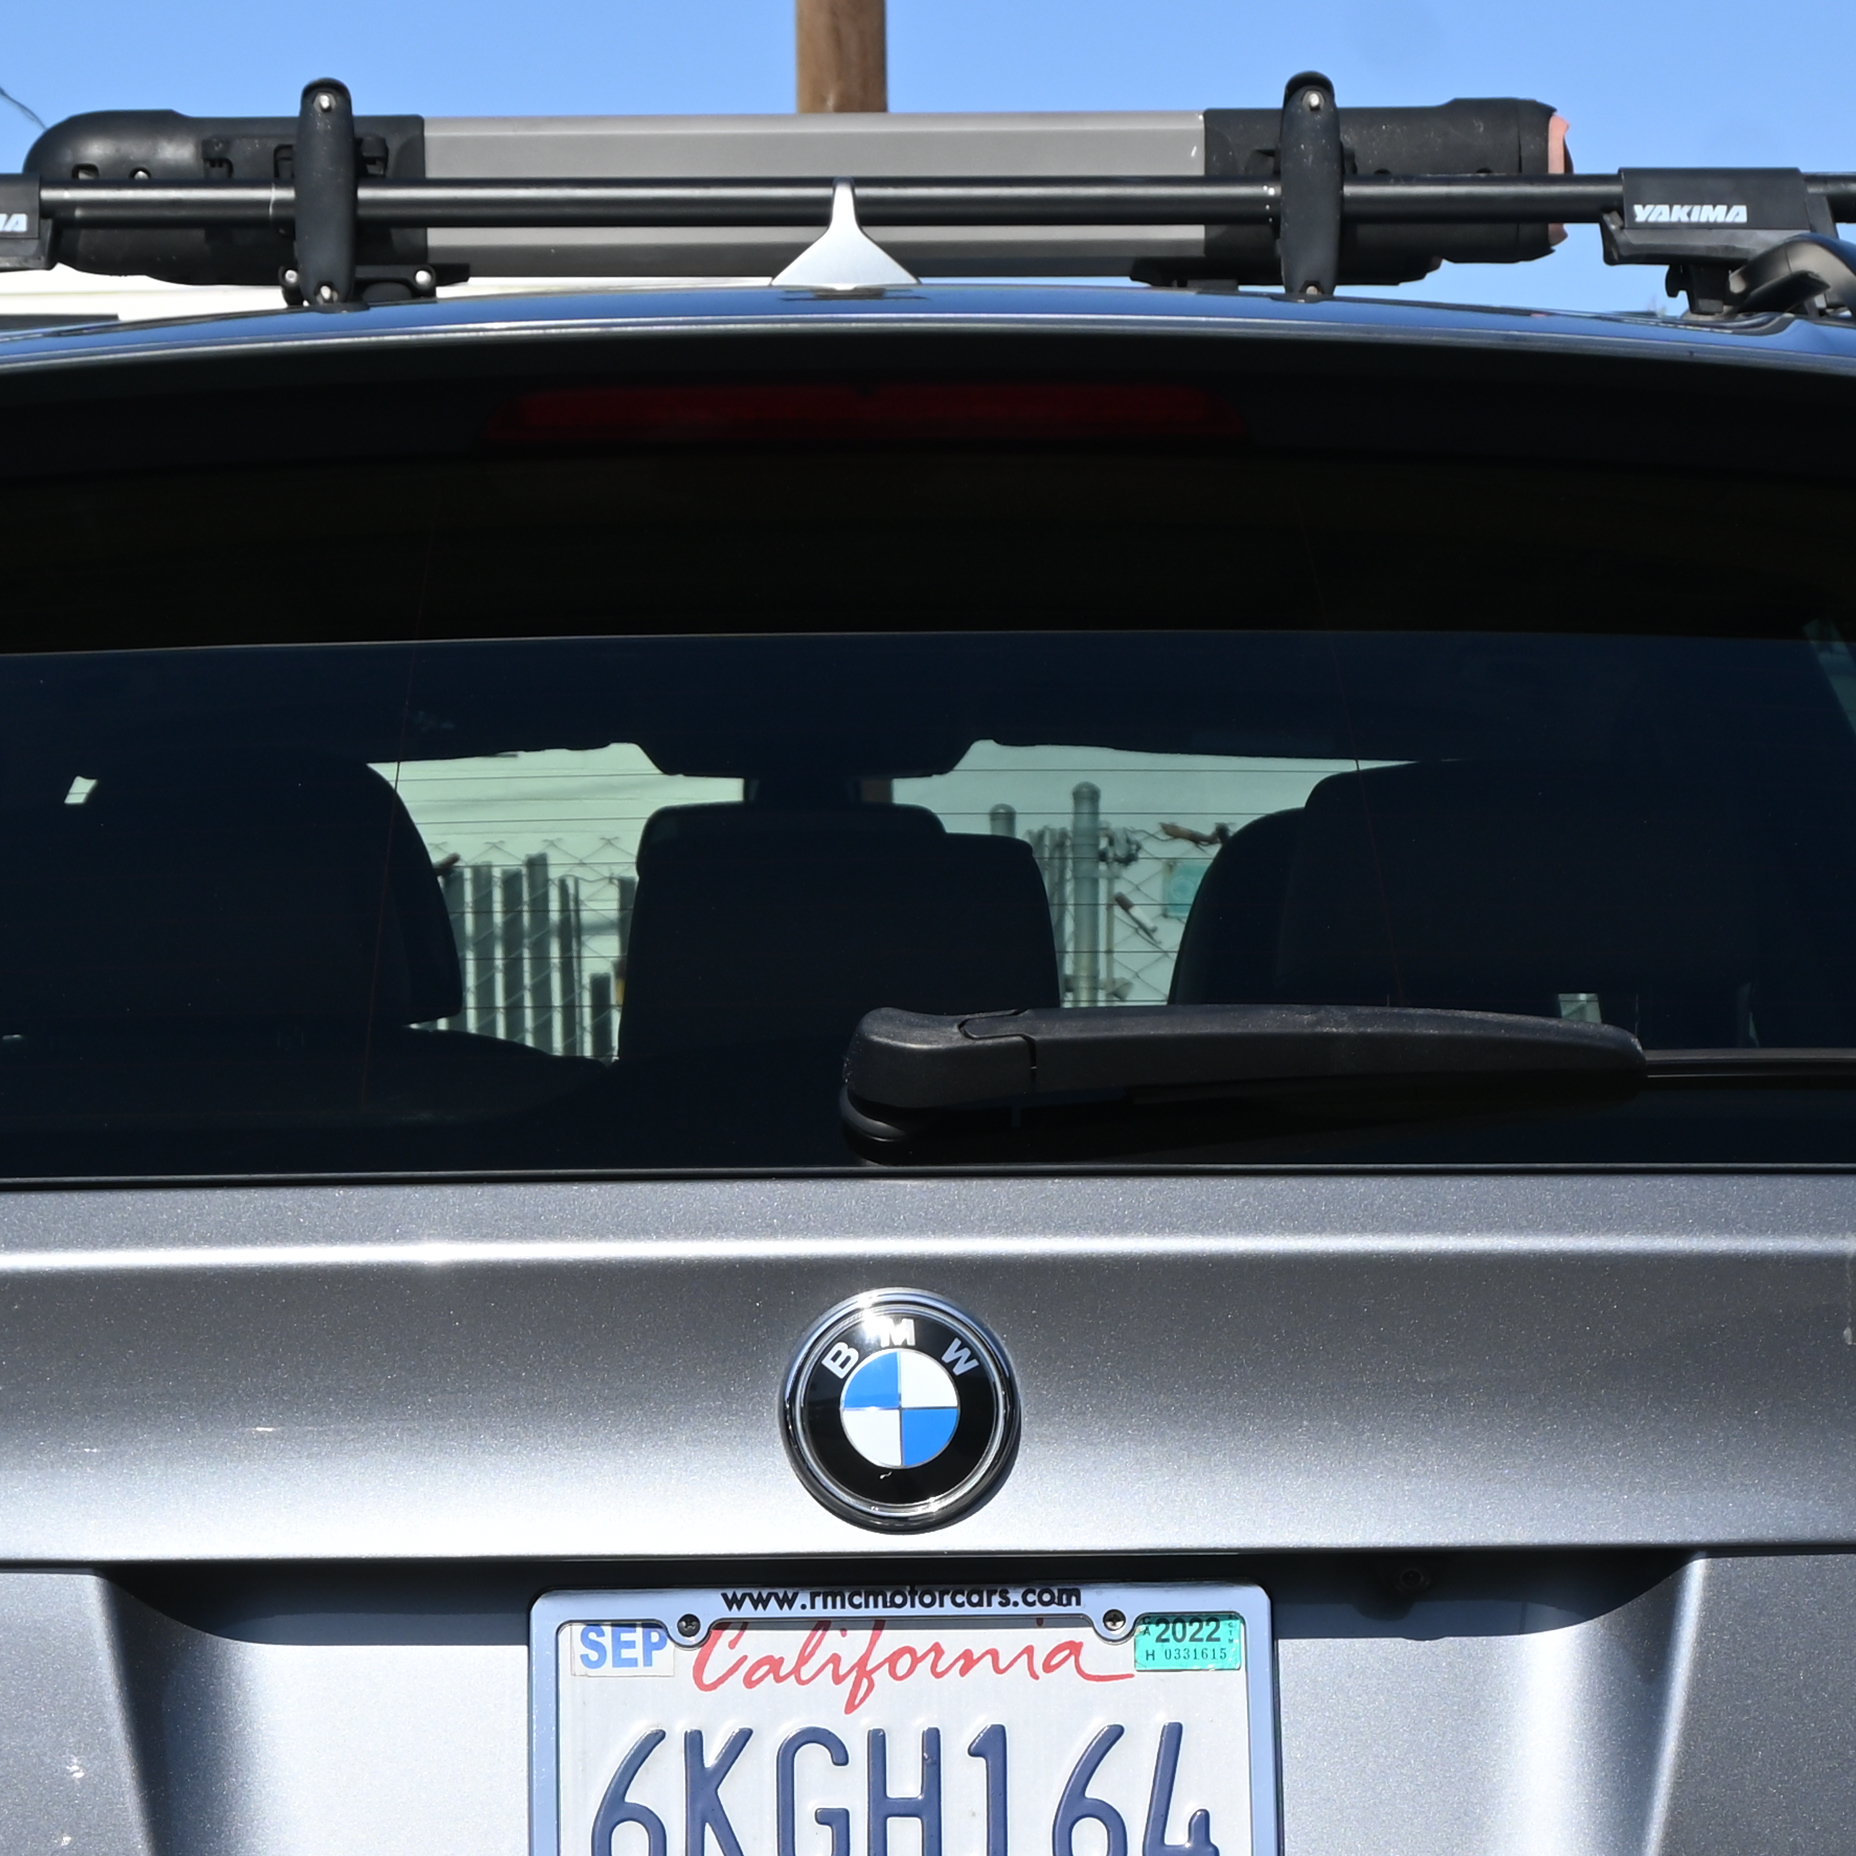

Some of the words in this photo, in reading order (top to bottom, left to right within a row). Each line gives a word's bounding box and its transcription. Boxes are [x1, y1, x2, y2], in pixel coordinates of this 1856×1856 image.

[1632, 204, 1748, 223] YAKIMA
[821, 1317, 980, 1379] BMW
[720, 1587, 1082, 1612] www.rmcmotorcars.com
[1155, 1617, 1221, 1643] 2022
[579, 1623, 669, 1669] SEP
[1145, 1649, 1156, 1661] H
[1164, 1647, 1228, 1660] 0331615
[693, 1618, 1135, 1715] California
